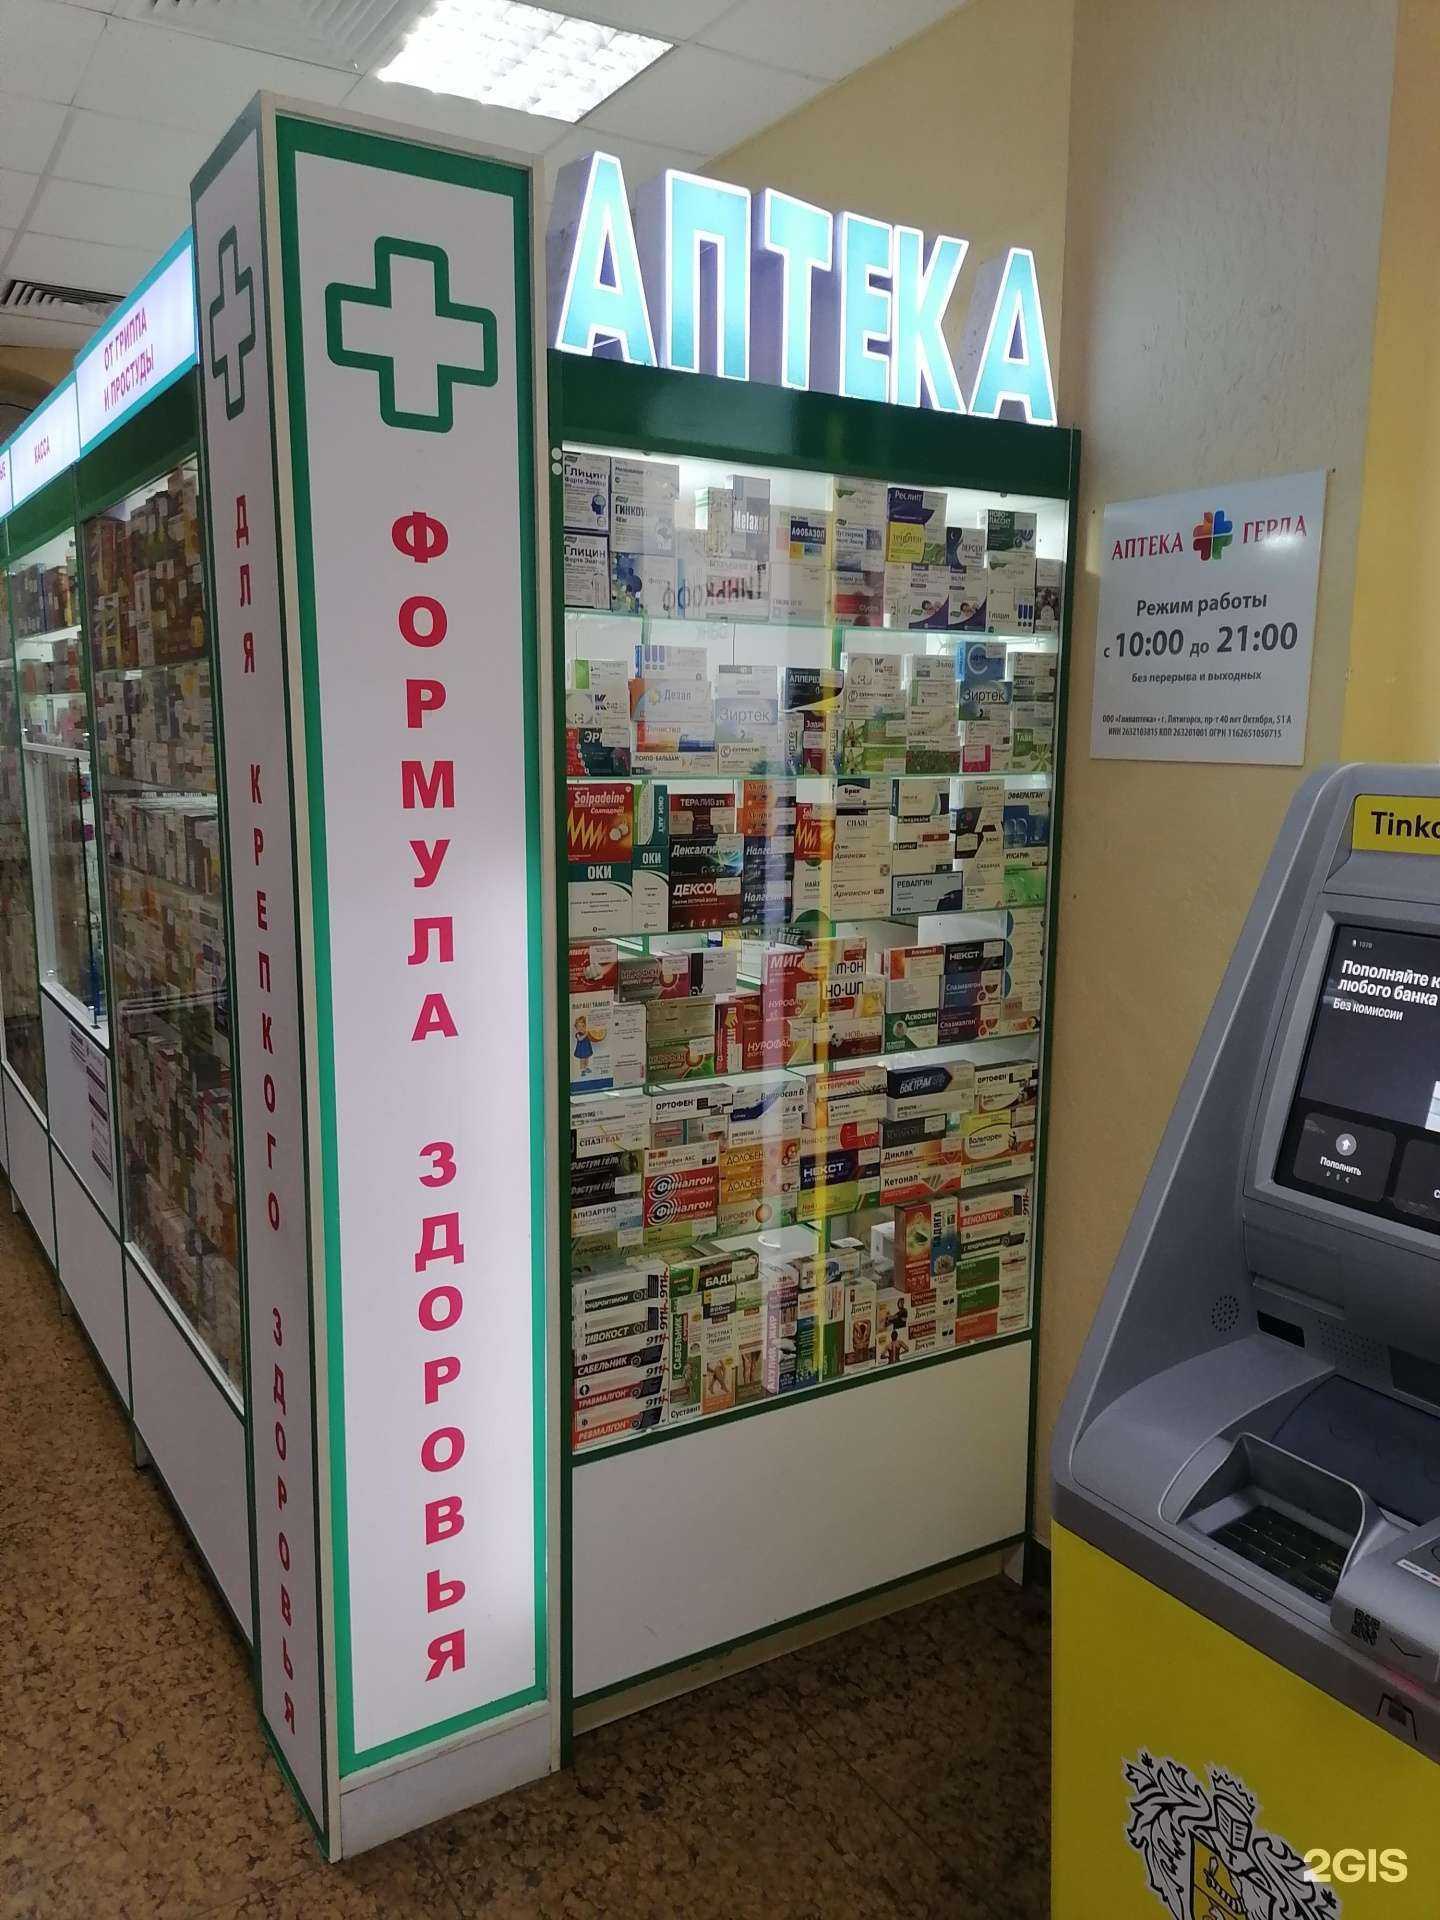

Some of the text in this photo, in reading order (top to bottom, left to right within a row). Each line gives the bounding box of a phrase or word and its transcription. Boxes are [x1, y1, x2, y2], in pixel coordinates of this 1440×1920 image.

[555, 150, 1058, 427] АПТЕКА
[104, 307, 148, 371] ОТ ГРИППА
[104, 344, 154, 411] И ПРОСТУДЫ
[34, 435, 50, 464] КАССА
[1112, 532, 1183, 560] АПТЕКА
[236, 495, 255, 673] ДЛЯ
[1137, 592, 1267, 616] Режим работы
[1103, 622, 1298, 658] с 10:00 до 21:00
[1149, 672, 1197, 684] перерыва
[1200, 672, 1205, 681] и
[1208, 671, 1262, 682] выходных
[963, 688, 1005, 703] Зиртек
[720, 708, 770, 722] Зиртек
[392, 512, 456, 1040] ФОРМУЛА
[574, 791, 625, 807] Solpadeine
[642, 852, 661, 864] ОКИ
[587, 865, 612, 880] ОКИ
[897, 880, 933, 889] РЕВАЛГИН
[949, 951, 980, 960] НЕКСТ
[1342, 960, 1429, 986] Пополняйте
[250, 764, 280, 1231] КРЕПКОГО
[1338, 979, 1438, 1006] любого банка
[1333, 998, 1404, 1020] Без комиссии
[656, 1101, 694, 1110] ОРТОФЕН
[884, 1152, 913, 1161] Диклак
[1320, 1156, 1362, 1176] Пополнить
[803, 1163, 844, 1178] НЕКСТ
[884, 1174, 918, 1187] Кетонал
[657, 1175, 714, 1192] Финалгон
[572, 1206, 617, 1220] АПИЗАРТРО
[656, 1200, 712, 1217] Финалгон
[673, 1314, 682, 1370] САБЕЛЬНИК
[577, 1356, 628, 1376] САБЕЛЬНИК
[415, 1142, 465, 1680] ЗДОРОВЬЯ
[273, 1307, 295, 1735] ЗДОРОВЬЯ
